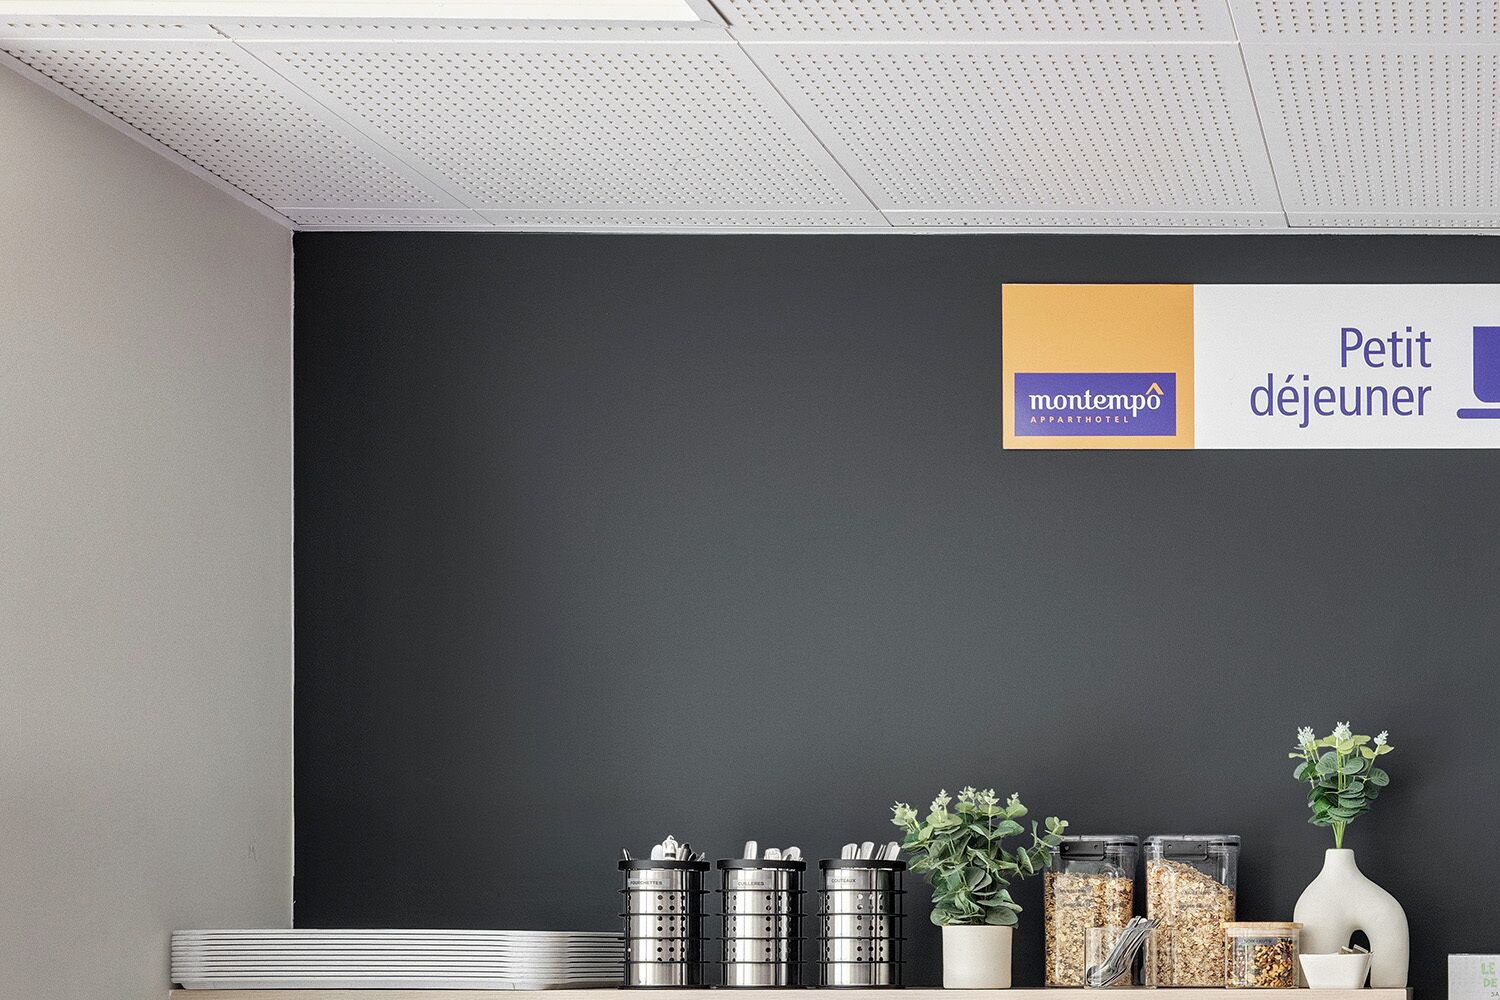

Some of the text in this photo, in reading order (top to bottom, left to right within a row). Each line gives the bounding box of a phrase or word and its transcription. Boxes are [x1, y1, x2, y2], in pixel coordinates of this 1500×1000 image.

[1341, 326, 1431, 368] Petit
[1029, 382, 1164, 418] montempô
[1250, 373, 1432, 428] déjeuner
[1030, 416, 1129, 424] APPARTHOTEL
[1481, 962, 1496, 976] LE
[1483, 978, 1497, 989] DE
